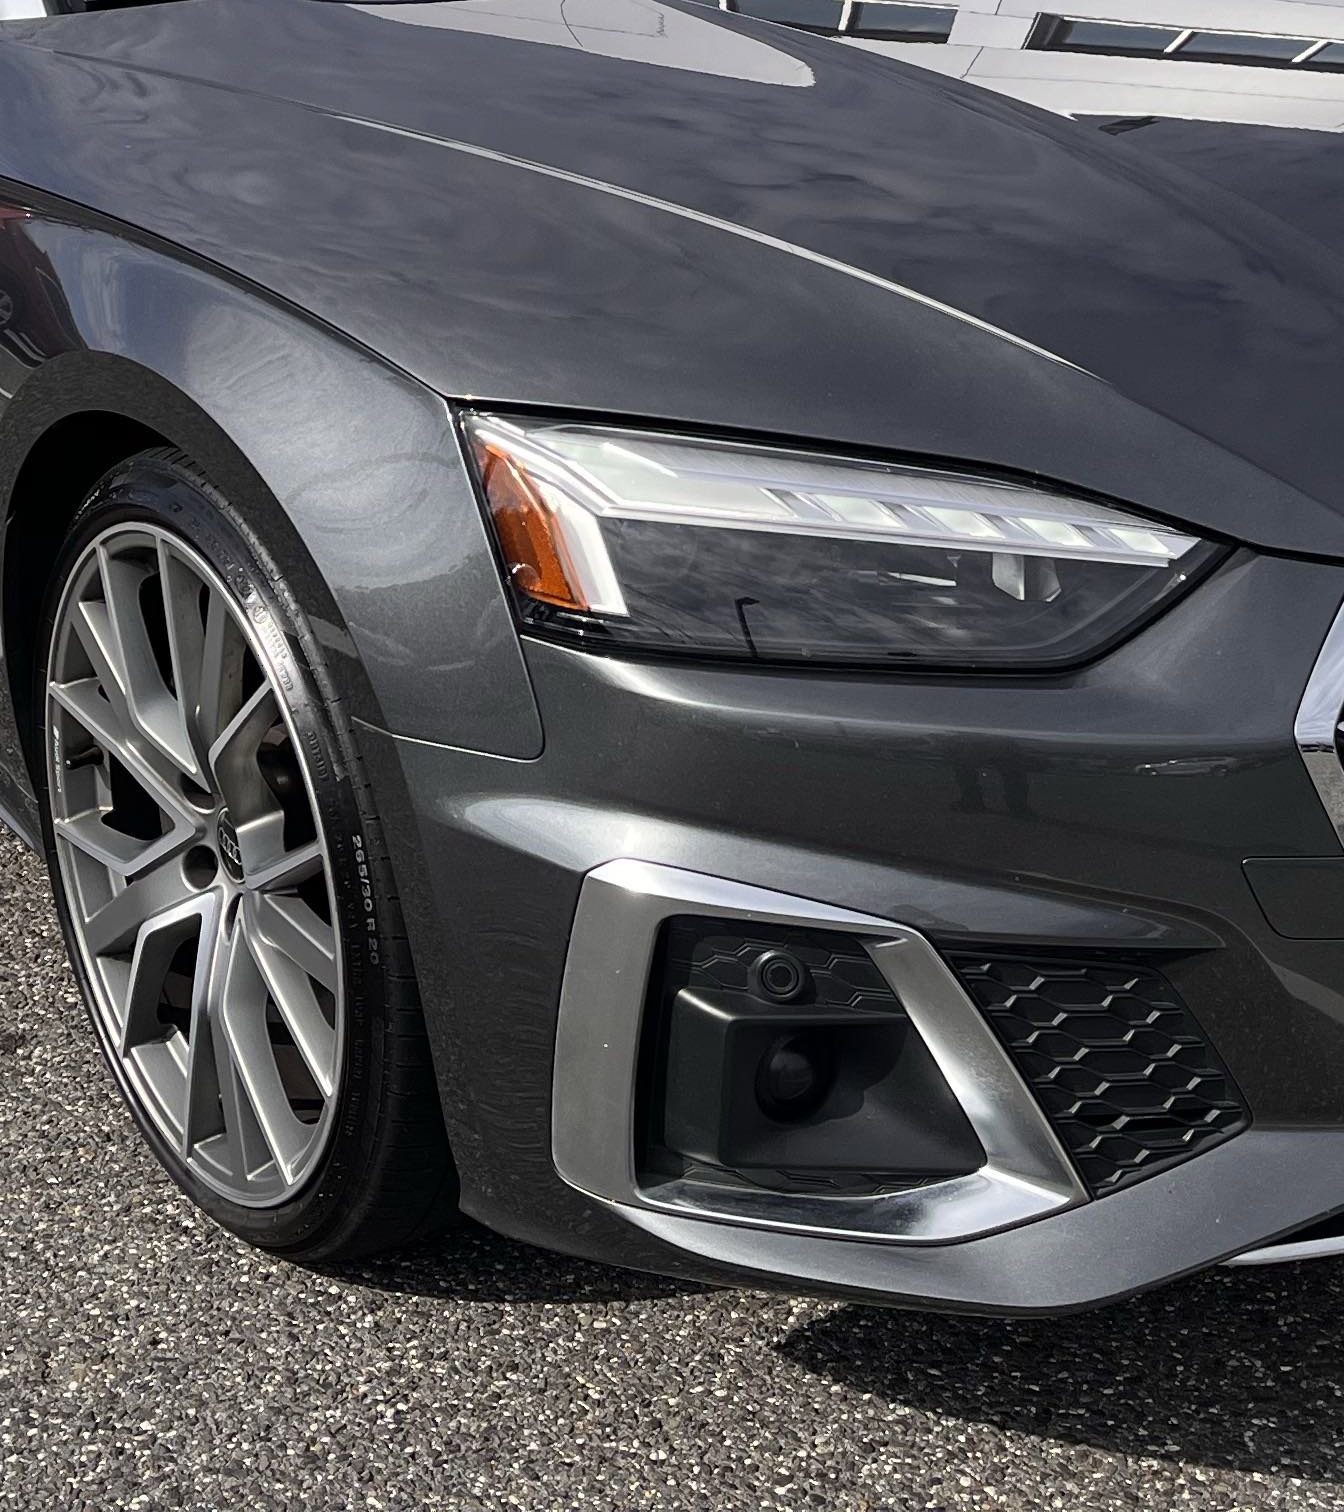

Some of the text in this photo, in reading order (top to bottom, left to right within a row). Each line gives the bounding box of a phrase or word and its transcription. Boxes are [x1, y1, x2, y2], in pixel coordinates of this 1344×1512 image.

[352, 834, 380, 965] 265/30 R 20
